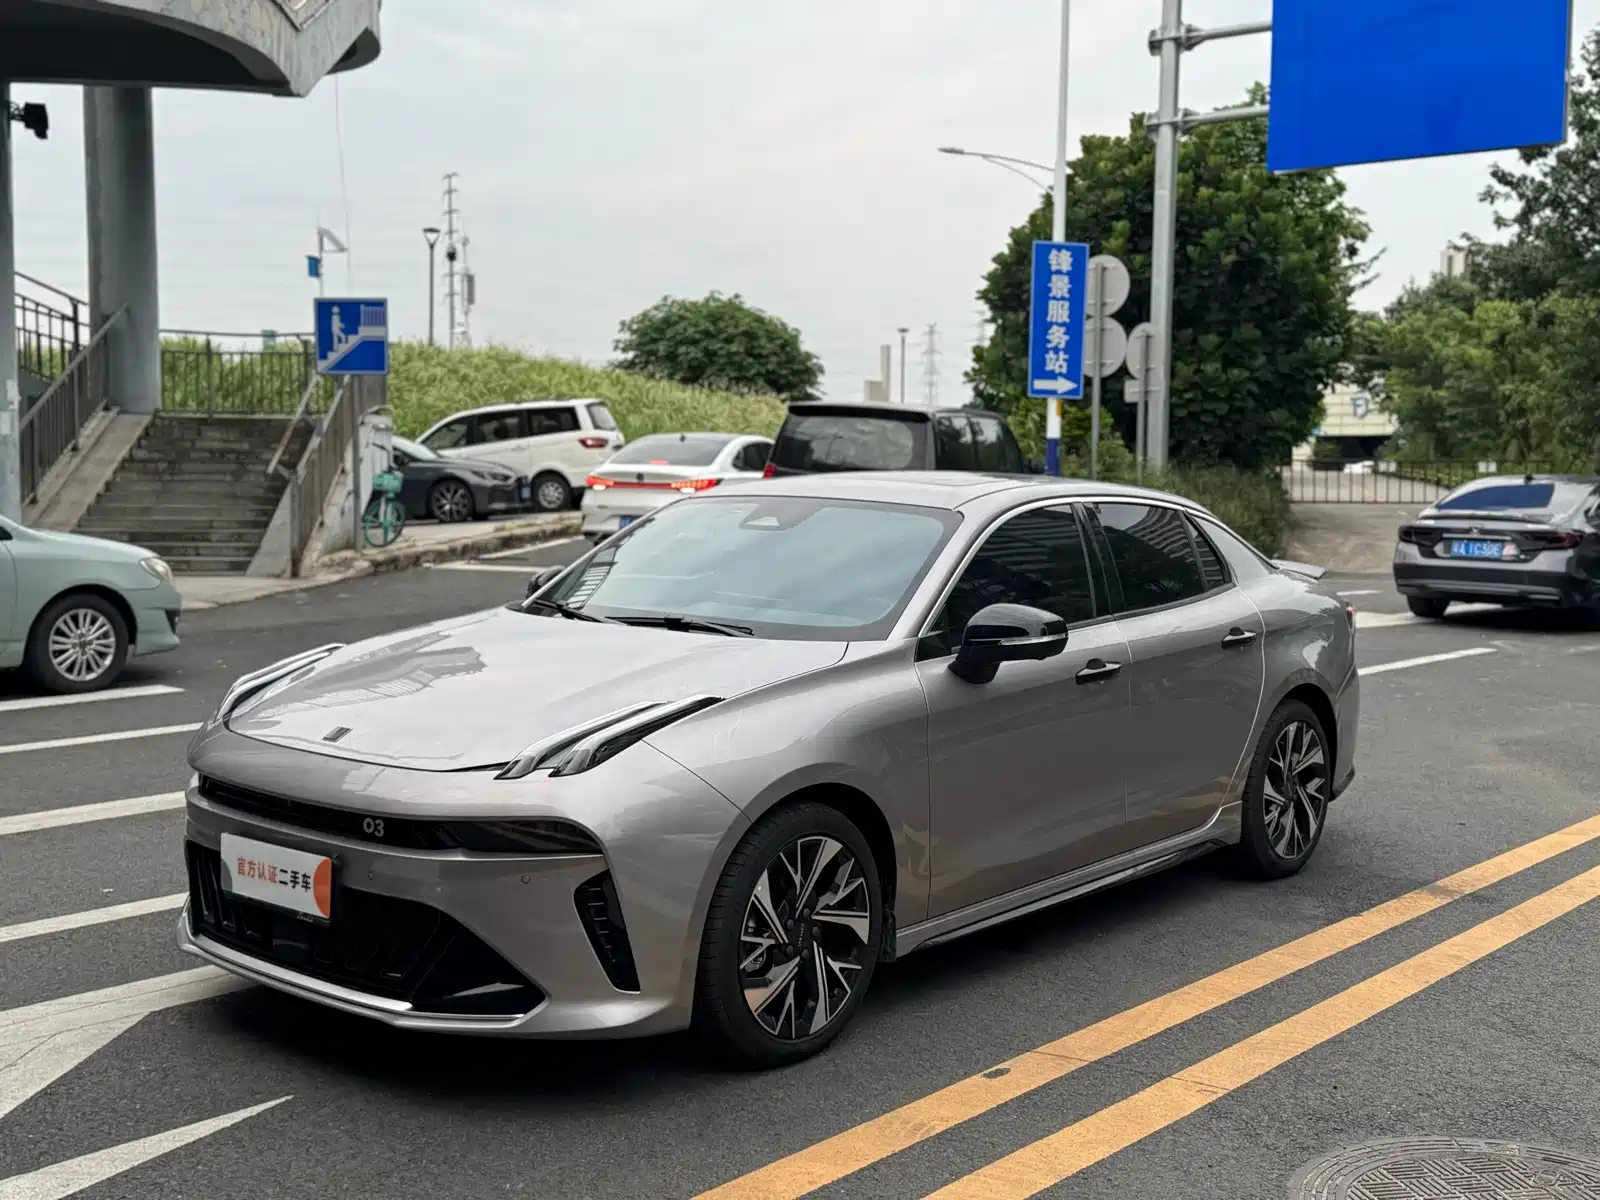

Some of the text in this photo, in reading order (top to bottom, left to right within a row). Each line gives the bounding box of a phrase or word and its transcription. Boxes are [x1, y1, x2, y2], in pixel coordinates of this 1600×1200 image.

[1045, 249, 1073, 374] 锋景服务站
[363, 817, 384, 837] 03
[236, 856, 311, 892] 官方认证二手车
